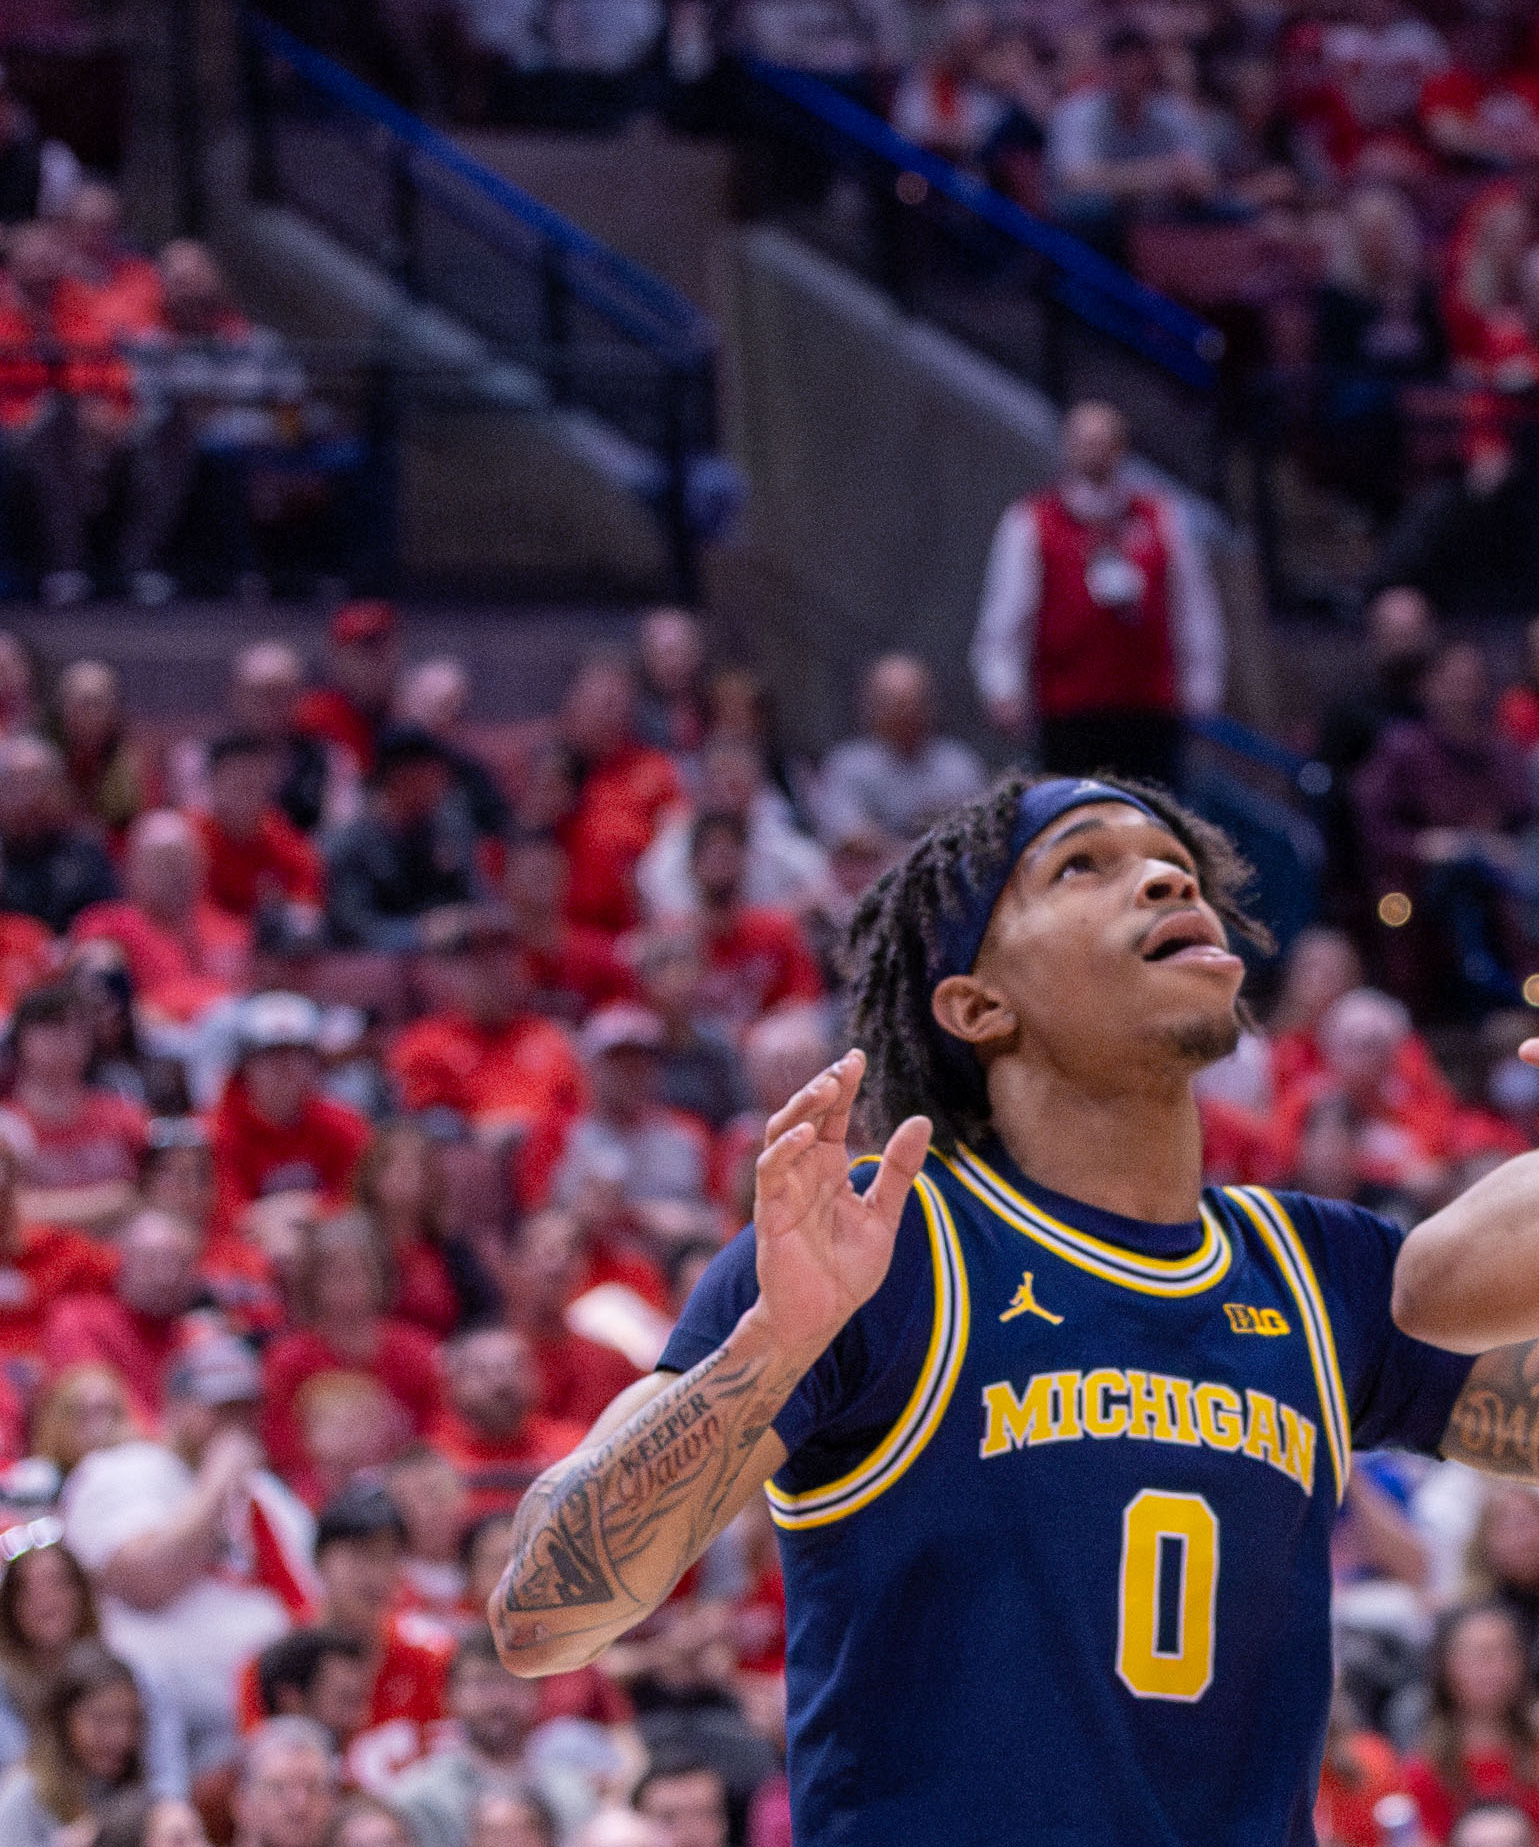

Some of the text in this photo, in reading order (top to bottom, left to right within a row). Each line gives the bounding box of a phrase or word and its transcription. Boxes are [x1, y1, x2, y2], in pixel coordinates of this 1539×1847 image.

[620, 1393, 711, 1476] KEEPER
[980, 1368, 1317, 1497] MICHIGAN
[1115, 1488, 1219, 1703] 0
